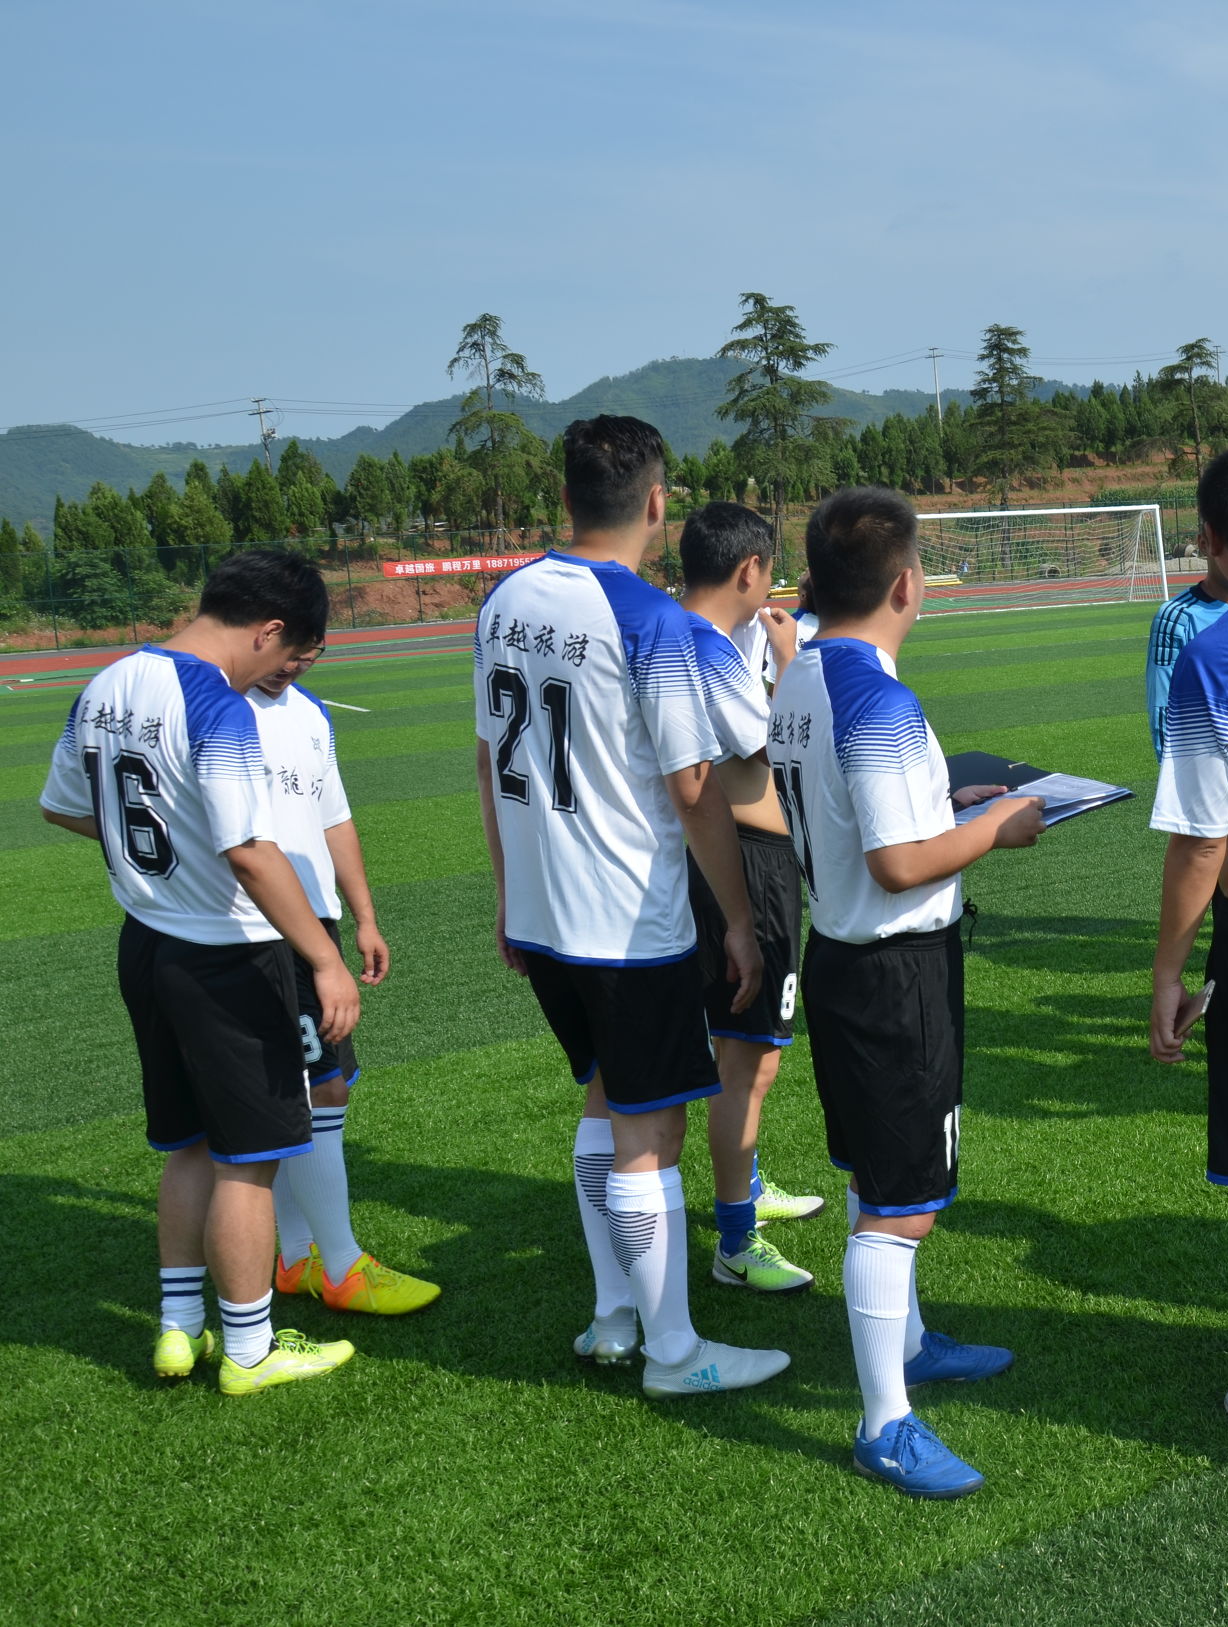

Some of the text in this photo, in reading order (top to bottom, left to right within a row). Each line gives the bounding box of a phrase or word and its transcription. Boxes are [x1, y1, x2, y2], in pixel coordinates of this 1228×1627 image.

[395, 561, 435, 575] 卓越国旅
[442, 560, 482, 572] 鹏程万里
[486, 614, 589, 667] 卓越旅游
[487, 662, 577, 814] 21
[82, 746, 179, 880] 16
[780, 973, 797, 1020] 8
